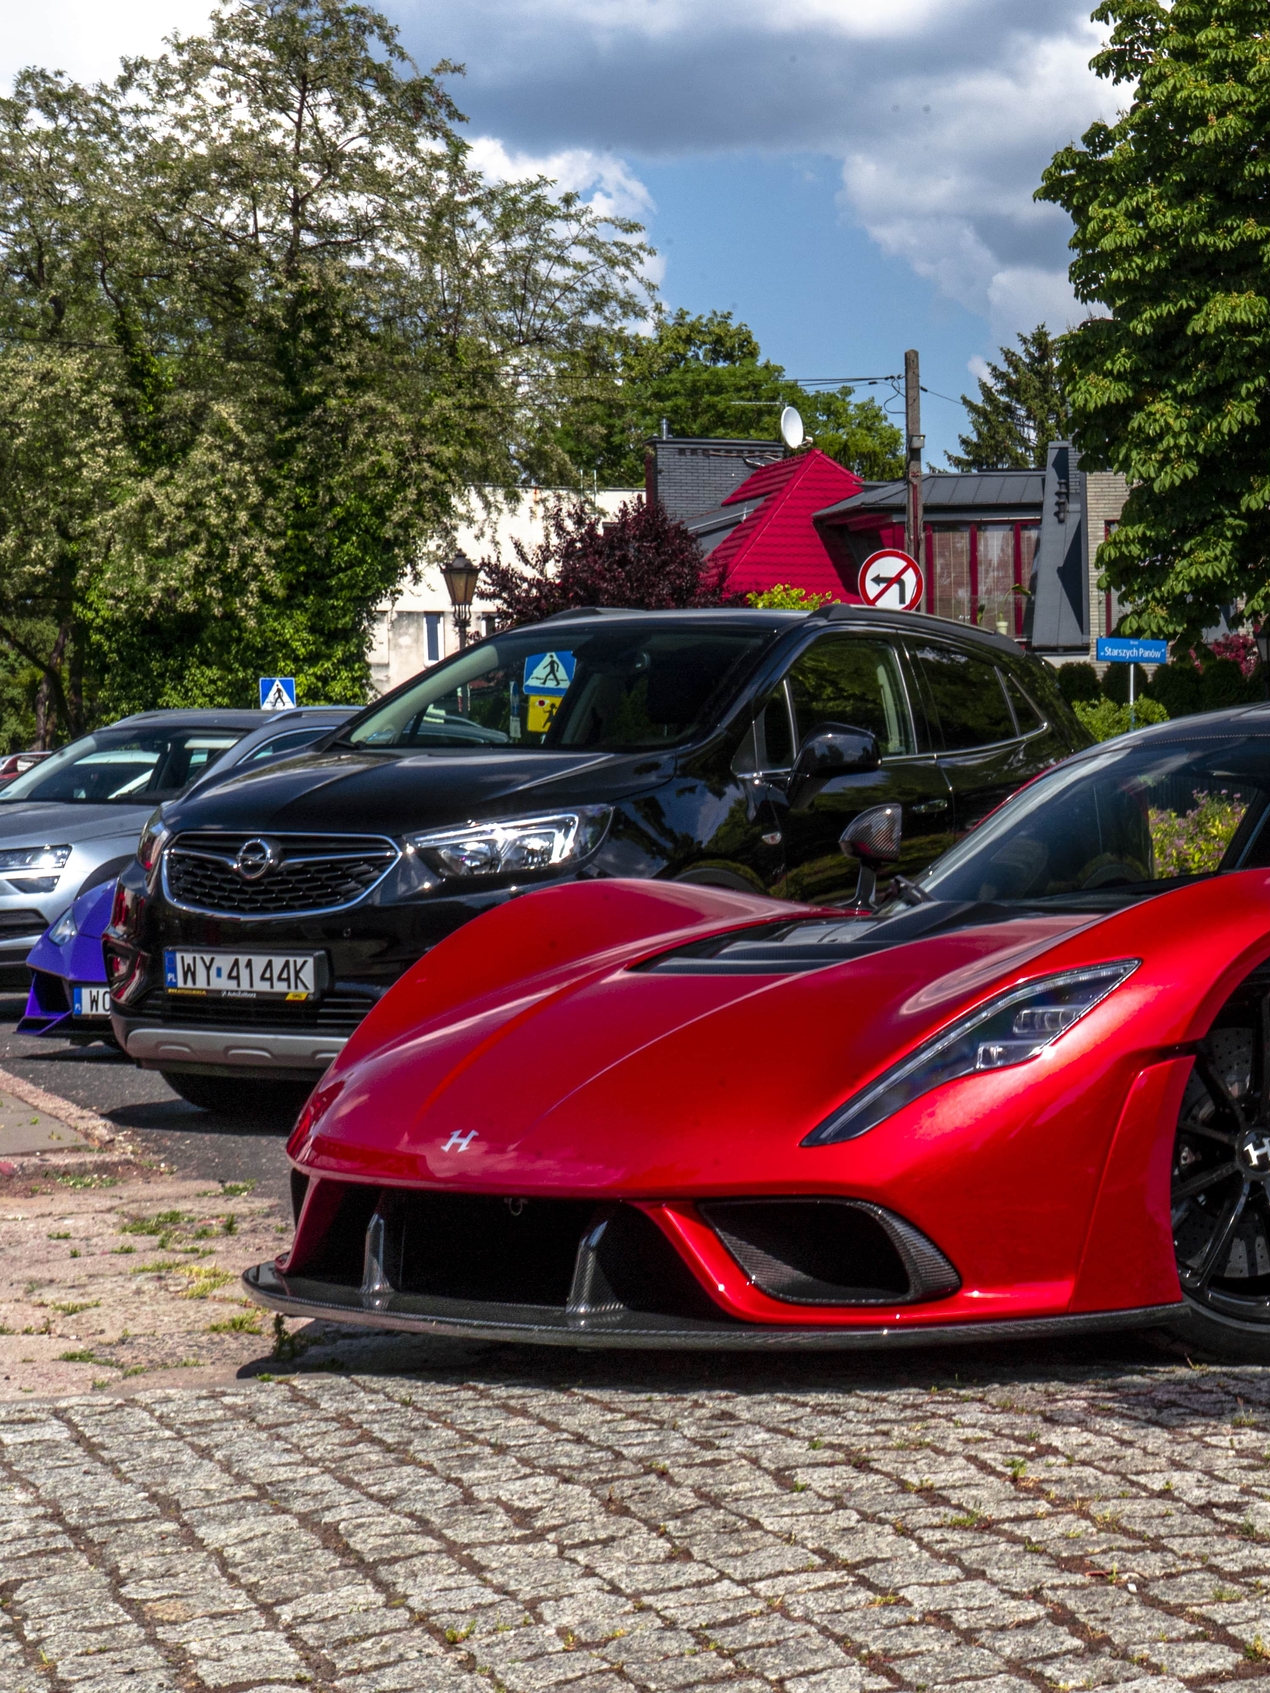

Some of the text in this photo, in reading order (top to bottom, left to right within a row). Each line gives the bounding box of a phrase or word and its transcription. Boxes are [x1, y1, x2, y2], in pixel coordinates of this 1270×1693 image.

[181, 955, 311, 991] WY 4144K
[441, 1129, 480, 1153] H
